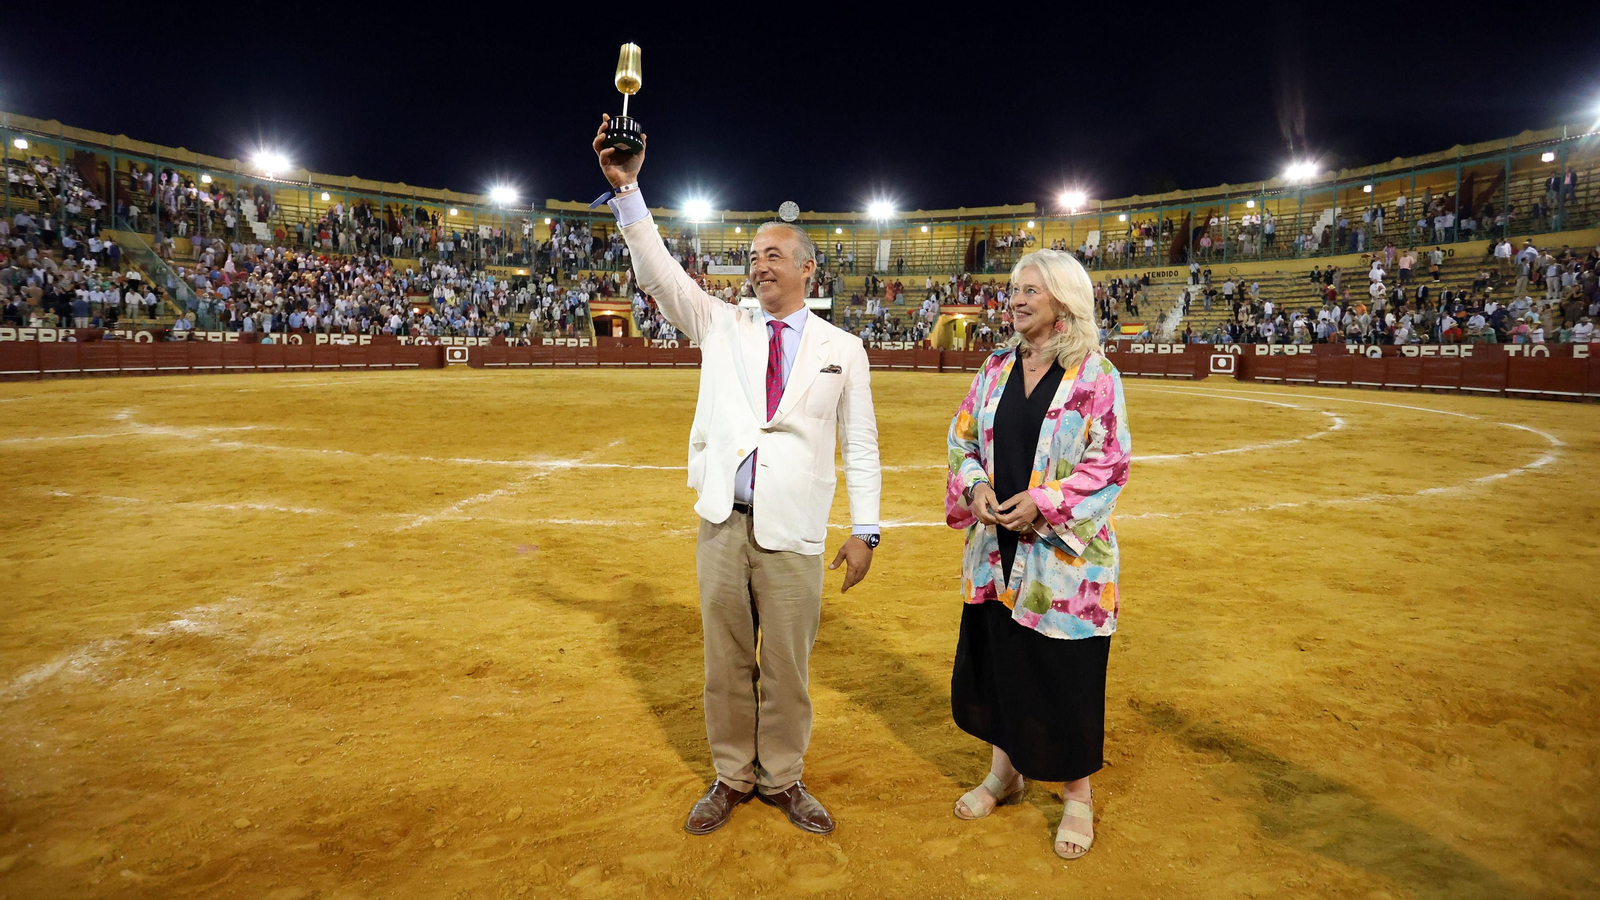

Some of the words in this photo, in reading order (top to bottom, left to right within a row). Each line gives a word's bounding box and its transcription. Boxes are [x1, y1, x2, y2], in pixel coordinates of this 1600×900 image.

[1147, 270, 1179, 279] TENDIDO
[542, 338, 590, 347] PEPE
[1214, 345, 1242, 355] TIO
[1346, 344, 1382, 358] TIO
[1402, 345, 1473, 357] PEPE
[1504, 344, 1550, 357] TIO
